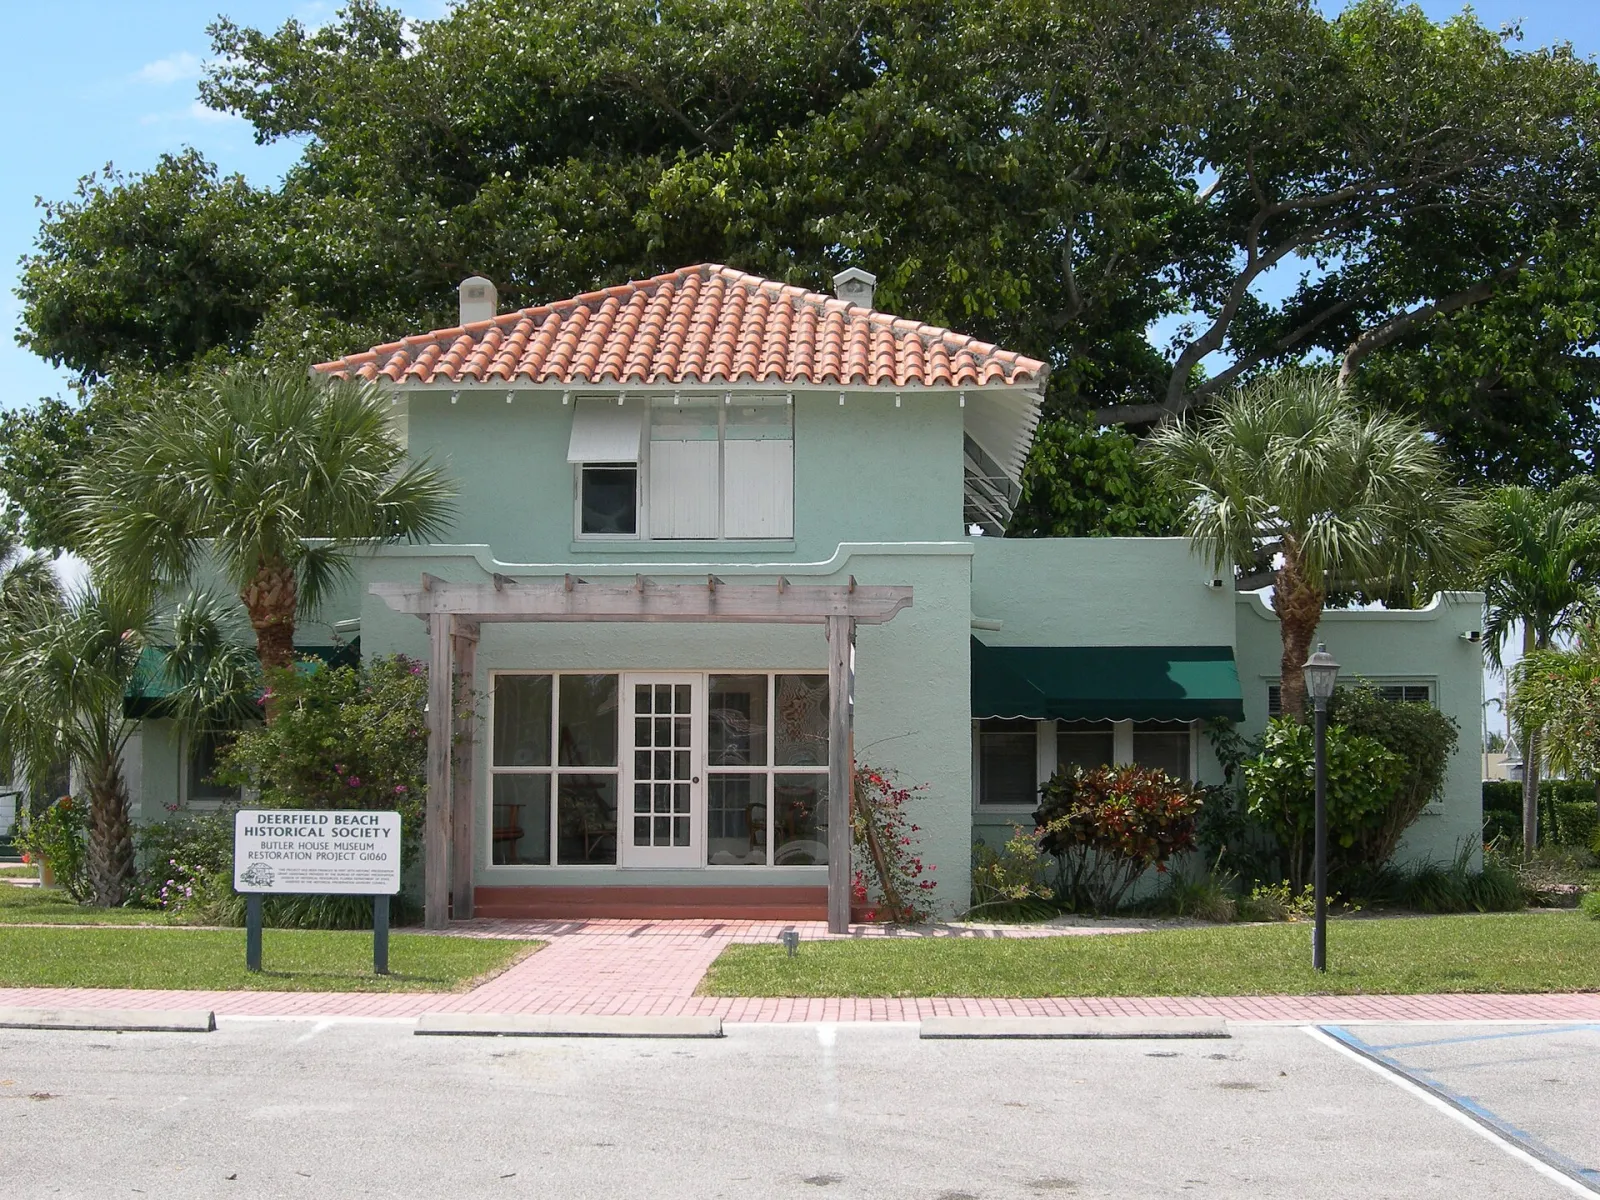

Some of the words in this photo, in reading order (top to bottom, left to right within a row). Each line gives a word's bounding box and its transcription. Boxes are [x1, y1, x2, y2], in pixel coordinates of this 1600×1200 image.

[257, 814, 329, 825] DEERFIELD
[334, 814, 379, 826] BEACH
[244, 826, 325, 837] HISTORICAL
[331, 827, 391, 838] SOCIETY
[260, 841, 294, 850] BUTLER
[298, 841, 330, 851] HOUSE
[334, 842, 375, 851] MUSEUM
[248, 850, 312, 860] RESTORATION
[316, 852, 355, 862] PROJECT
